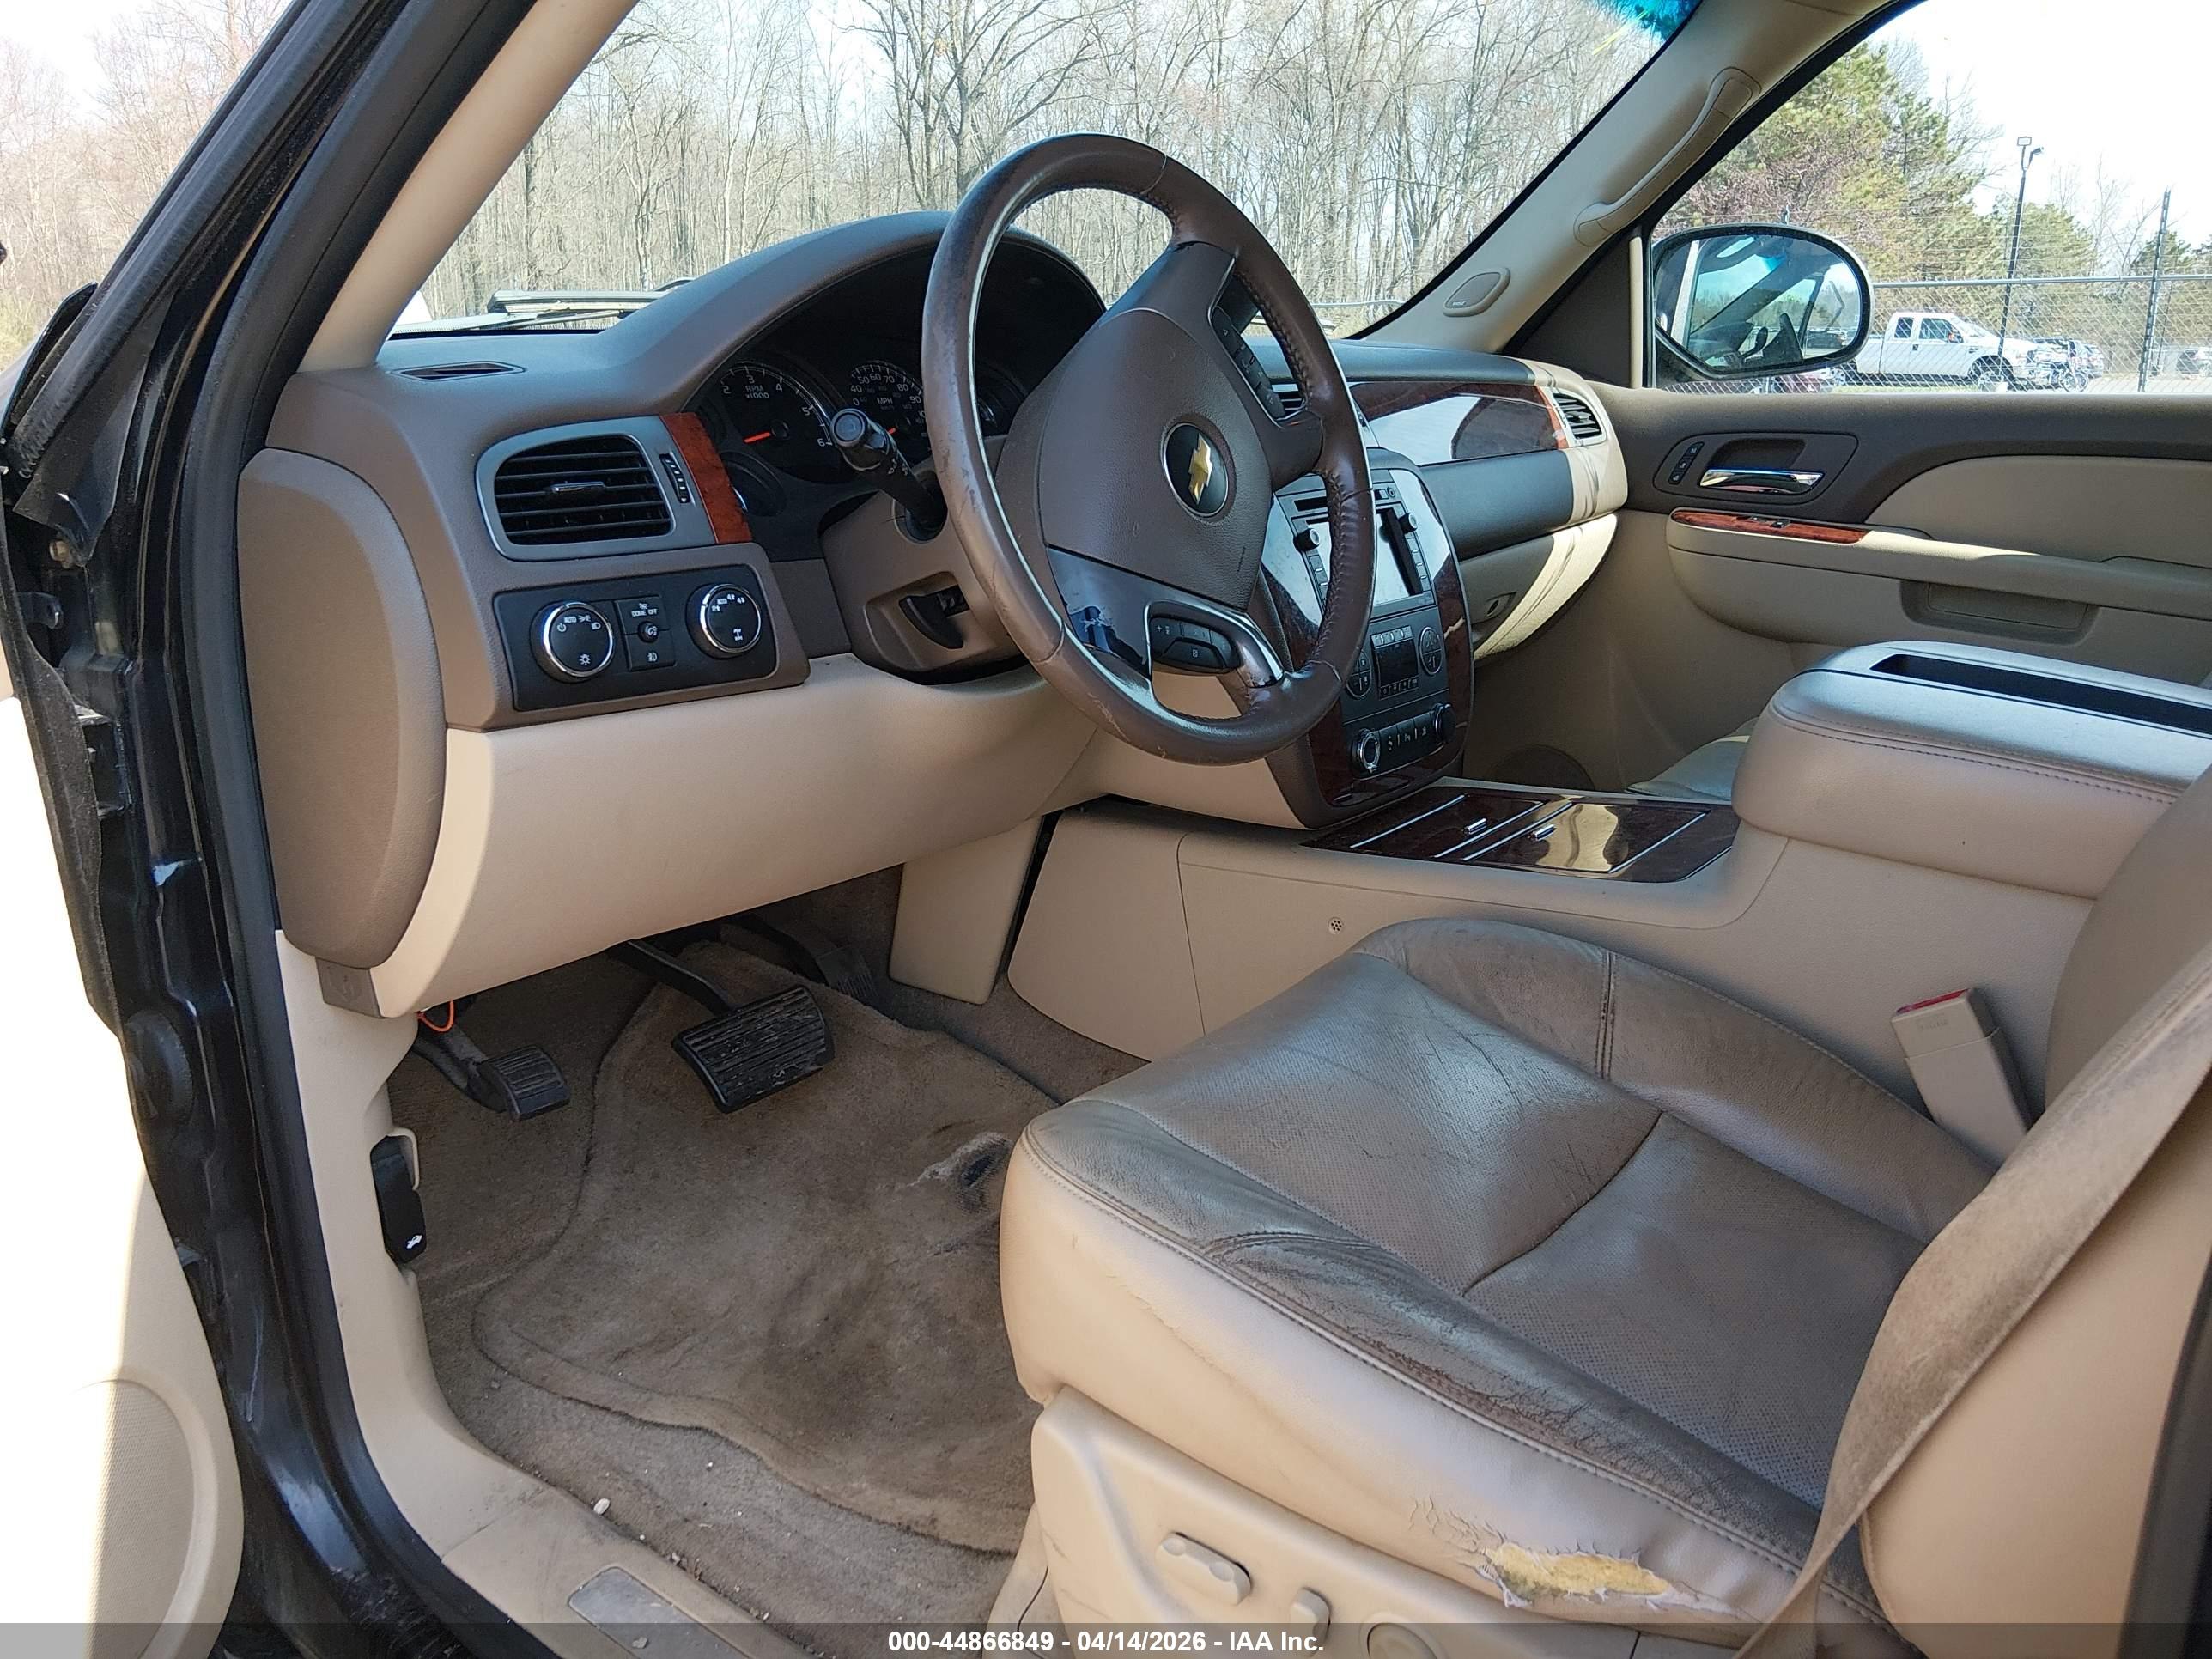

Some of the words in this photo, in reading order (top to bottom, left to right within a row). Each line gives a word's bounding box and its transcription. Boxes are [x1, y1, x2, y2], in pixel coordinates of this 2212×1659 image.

[746, 374, 756, 385] 3
[857, 376, 870, 385] 50
[869, 373, 882, 381] 60
[883, 375, 895, 384] 70
[721, 385, 732, 394] 2
[775, 383, 783, 392] 4
[850, 384, 863, 392] 40
[897, 383, 909, 392] 80
[853, 398, 860, 407] 0
[909, 395, 921, 404] 90
[802, 406, 811, 416] 5
[817, 438, 825, 447] 6
